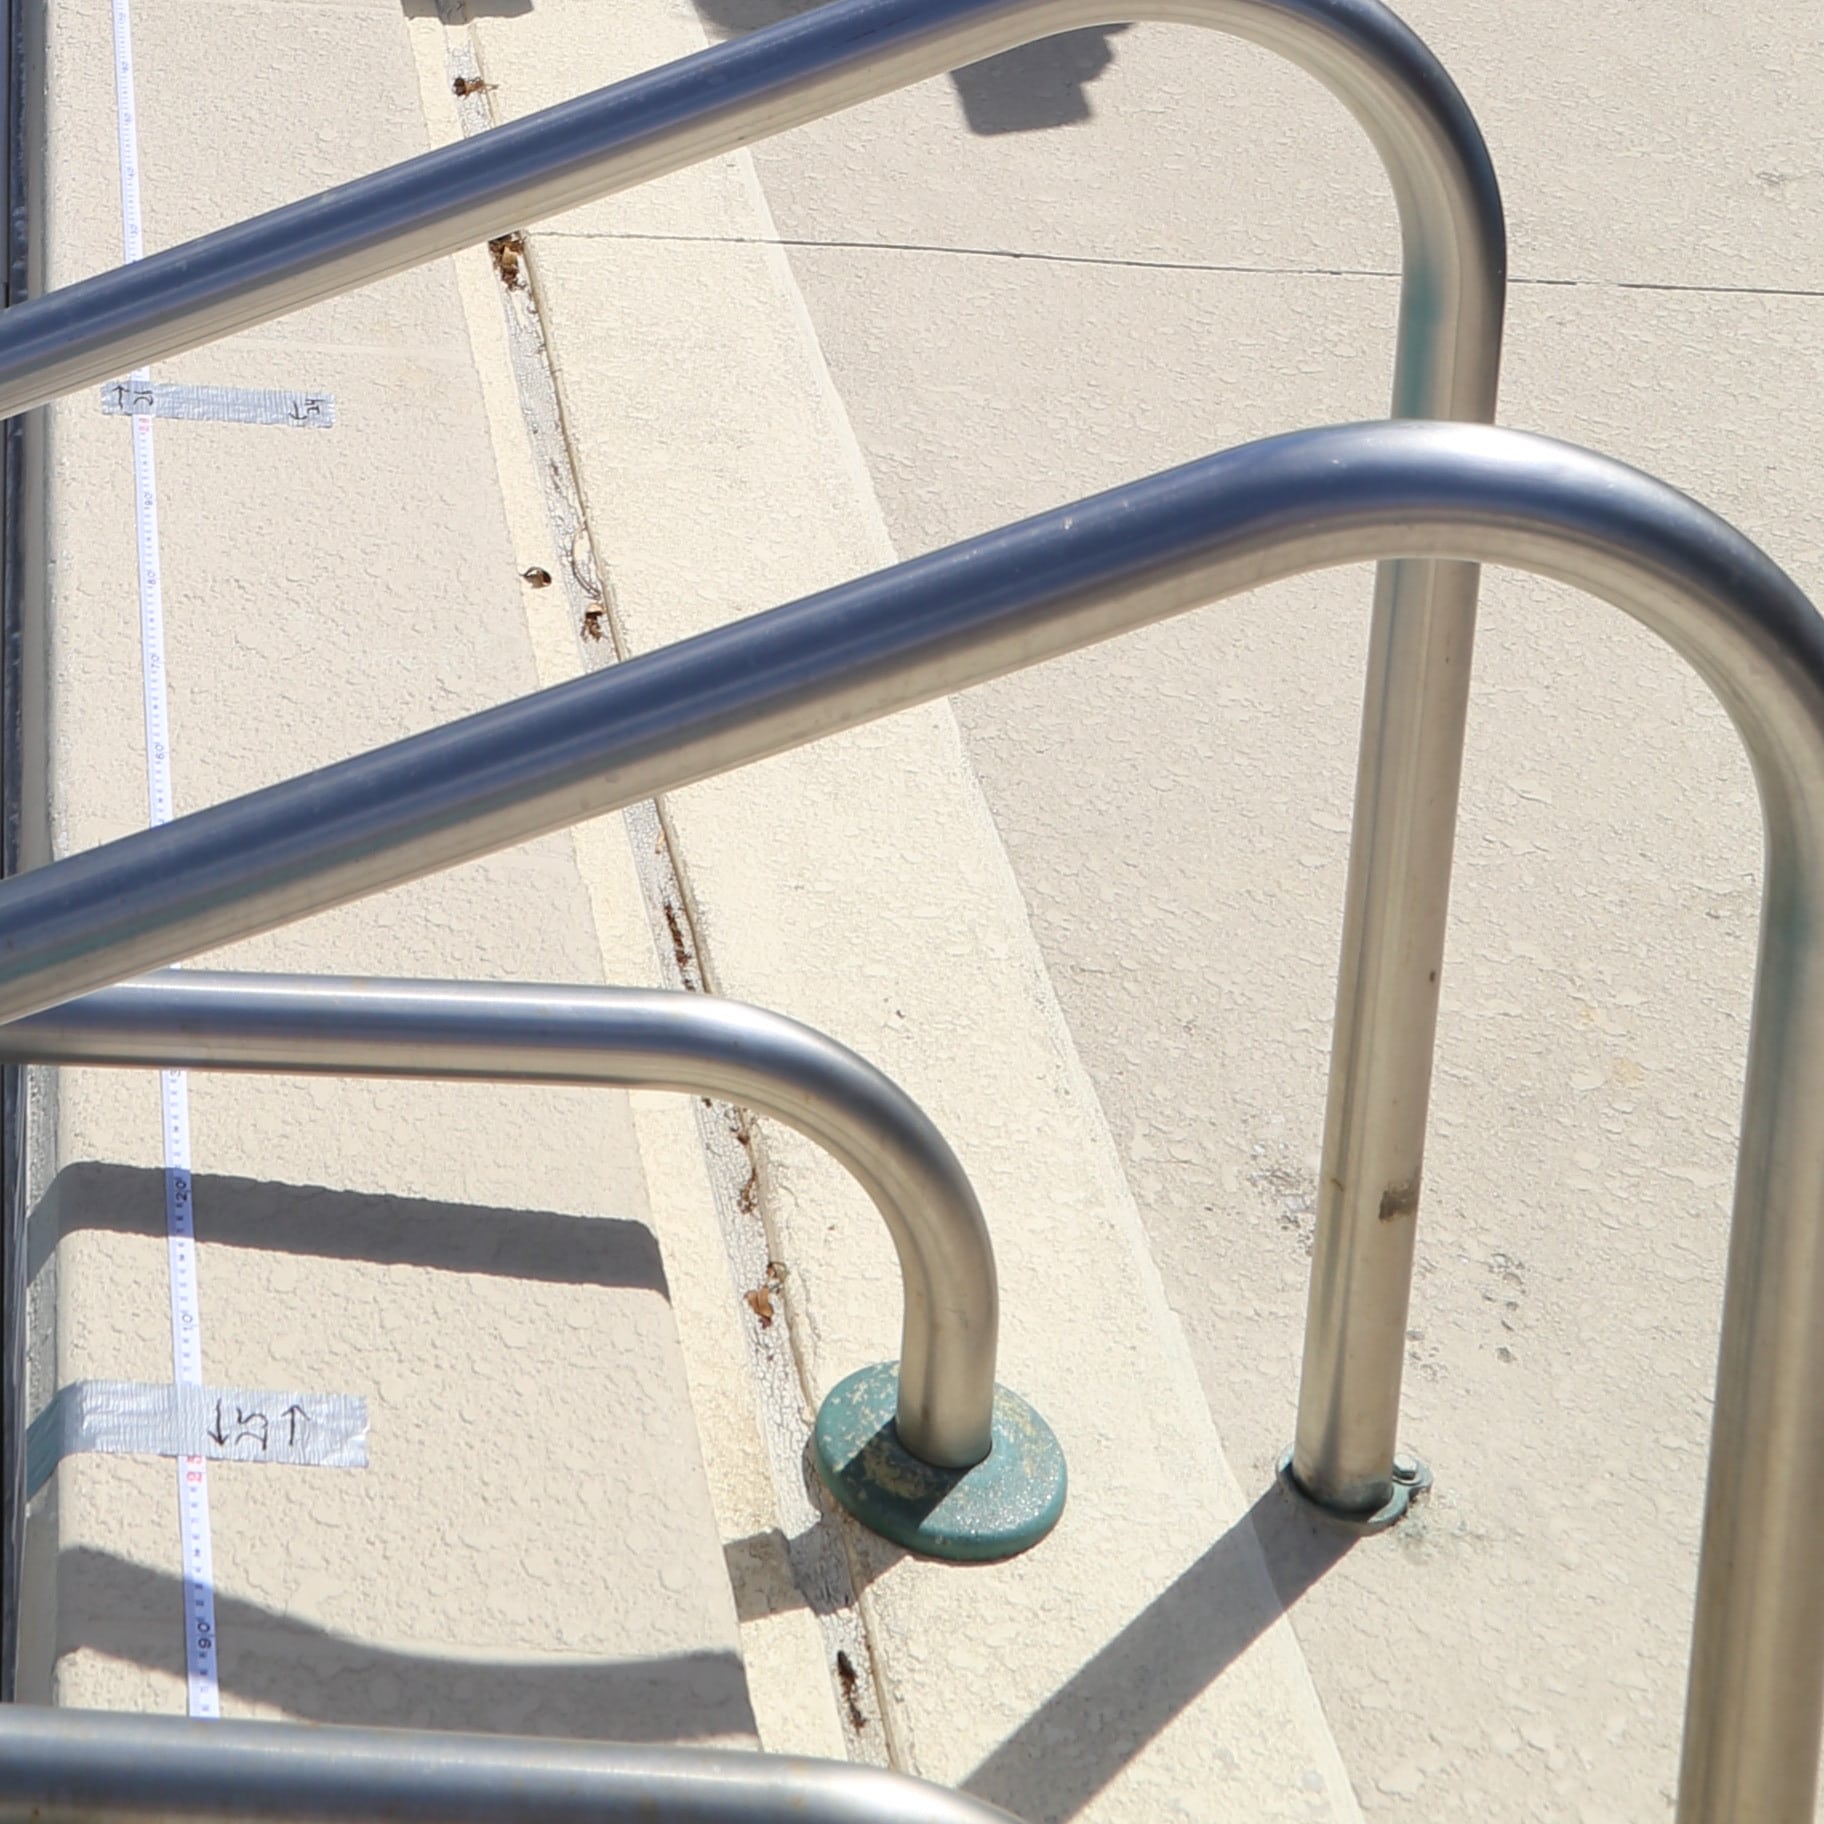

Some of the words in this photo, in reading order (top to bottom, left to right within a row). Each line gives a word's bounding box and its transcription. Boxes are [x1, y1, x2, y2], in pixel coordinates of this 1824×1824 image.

[174, 1179, 190, 1202] 20
[180, 1313, 195, 1333] 10
[235, 1407, 269, 1451] 25
[196, 1622, 213, 1650] 90
